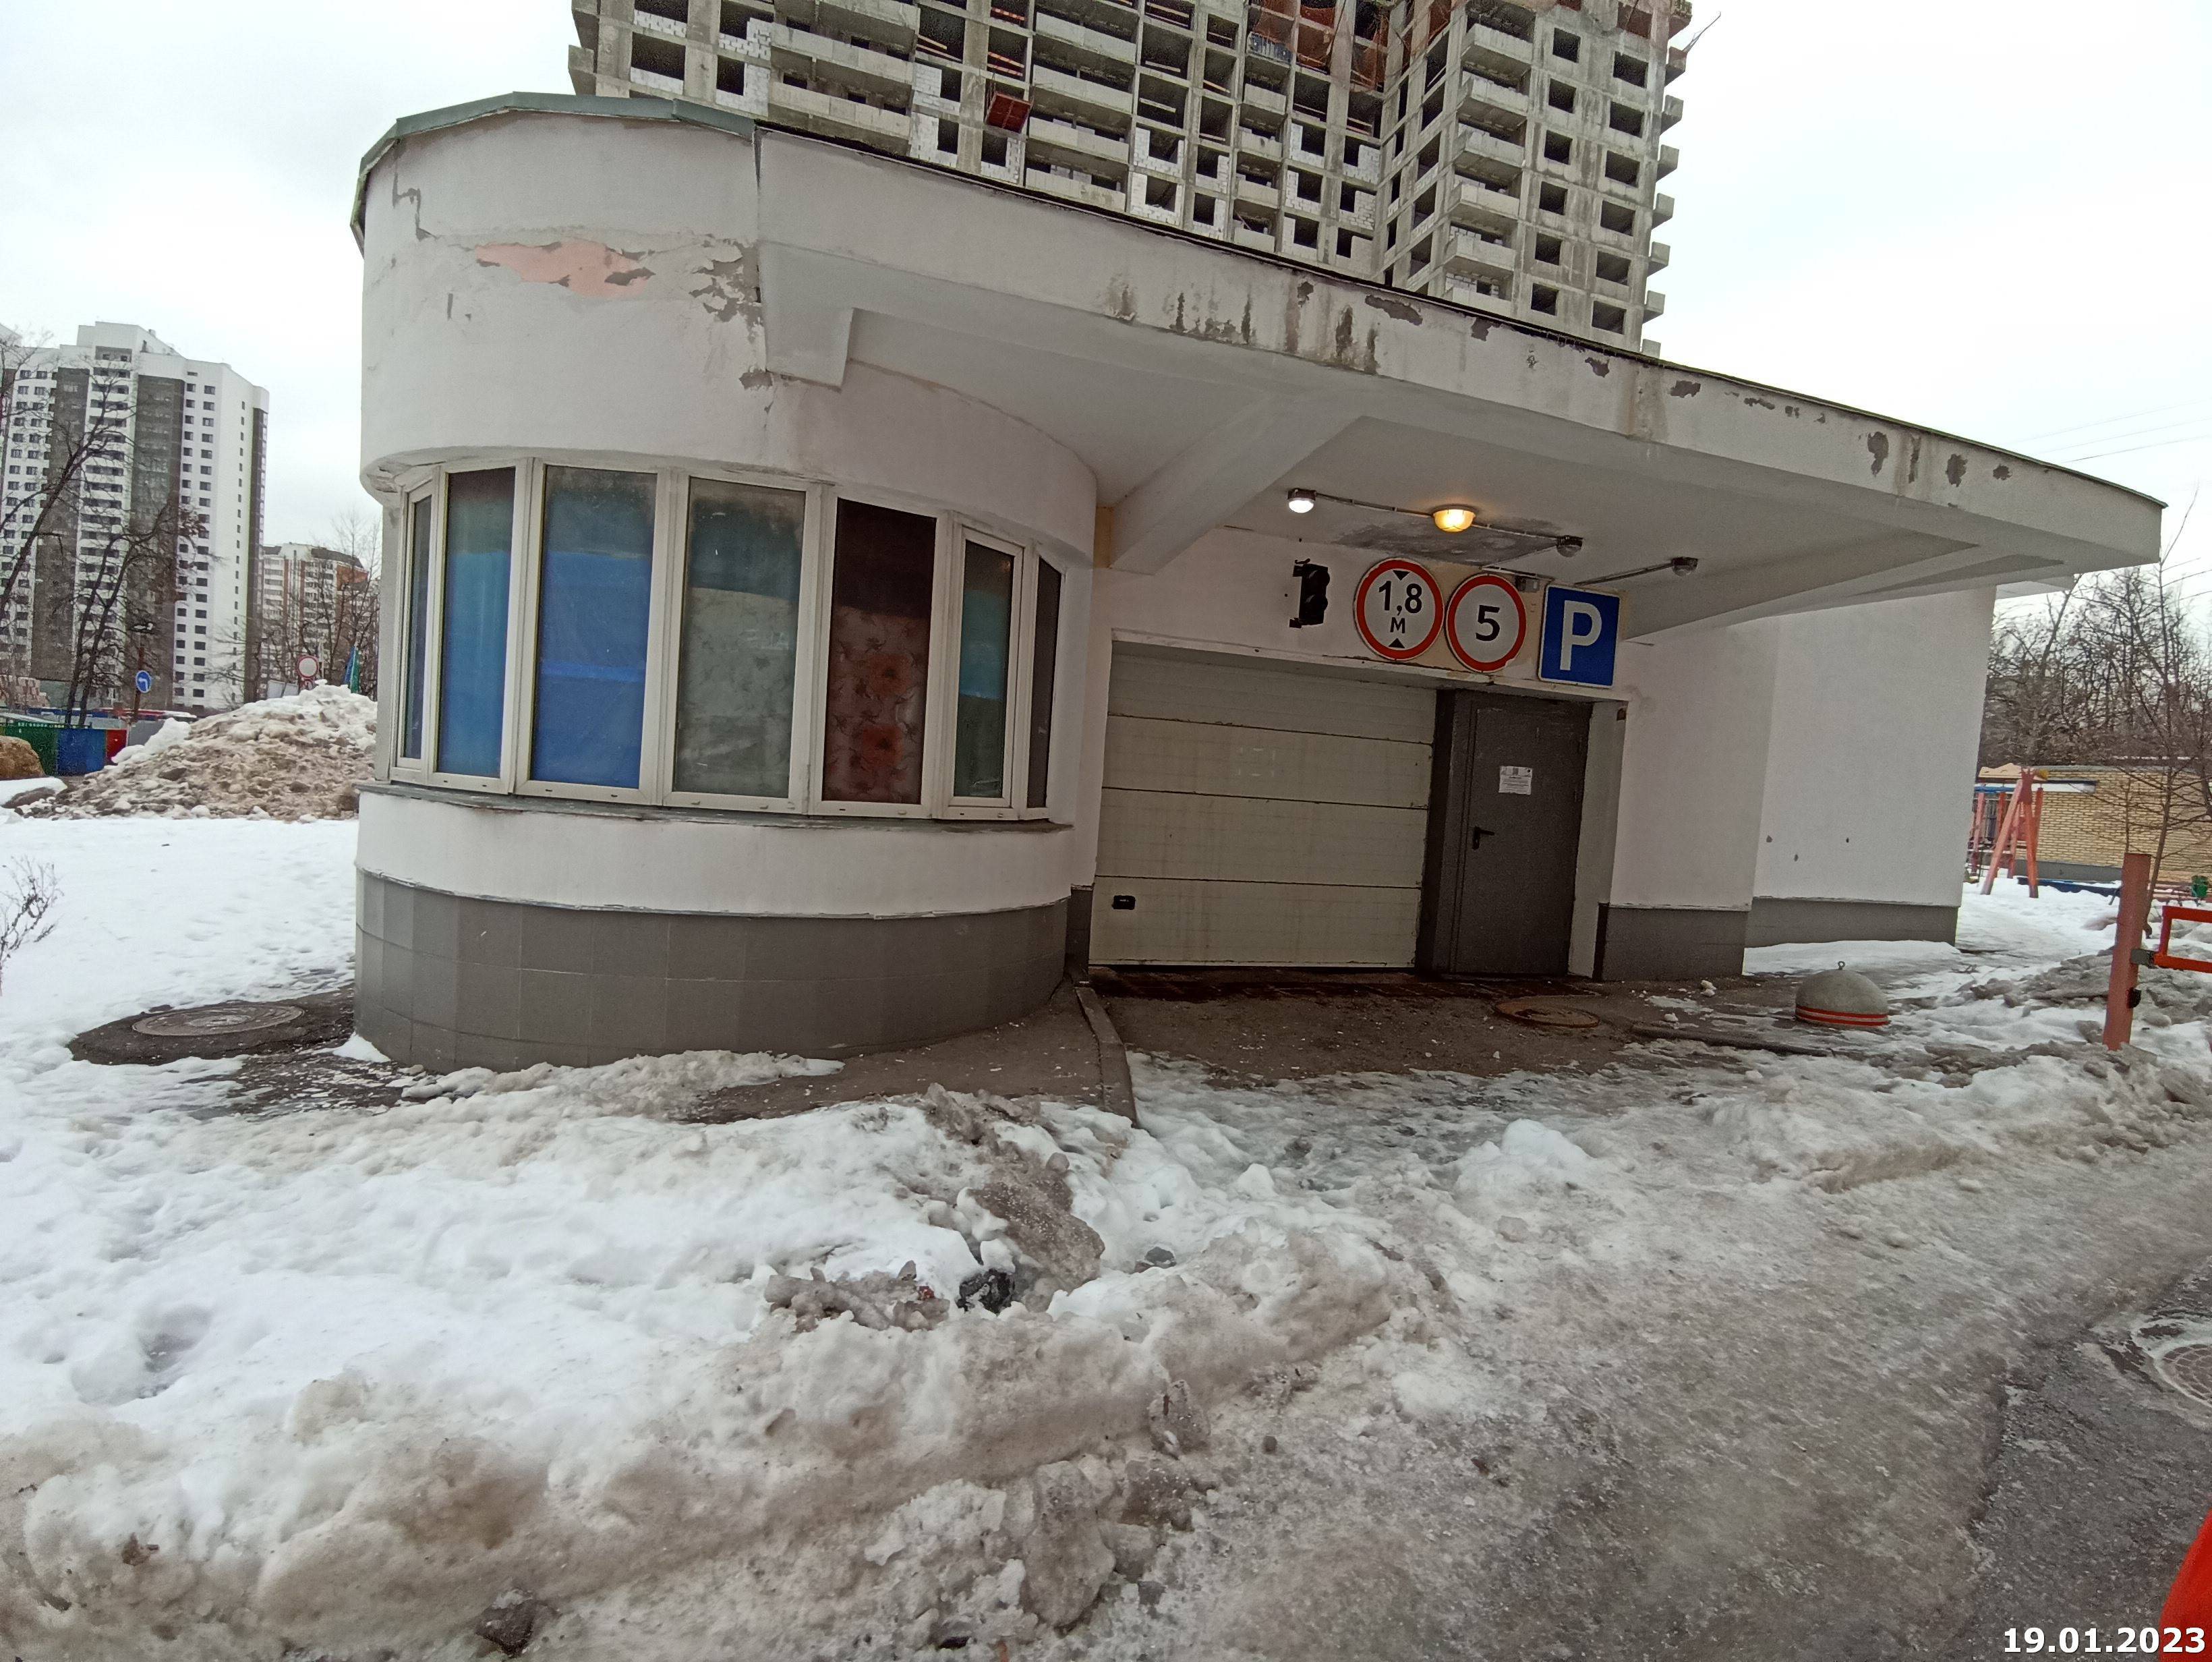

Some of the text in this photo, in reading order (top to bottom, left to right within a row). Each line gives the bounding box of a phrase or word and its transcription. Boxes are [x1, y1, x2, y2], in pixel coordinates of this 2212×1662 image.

[1378, 580, 1422, 616] 1,8
[1476, 604, 1501, 641] 5
[1560, 600, 1602, 670] P
